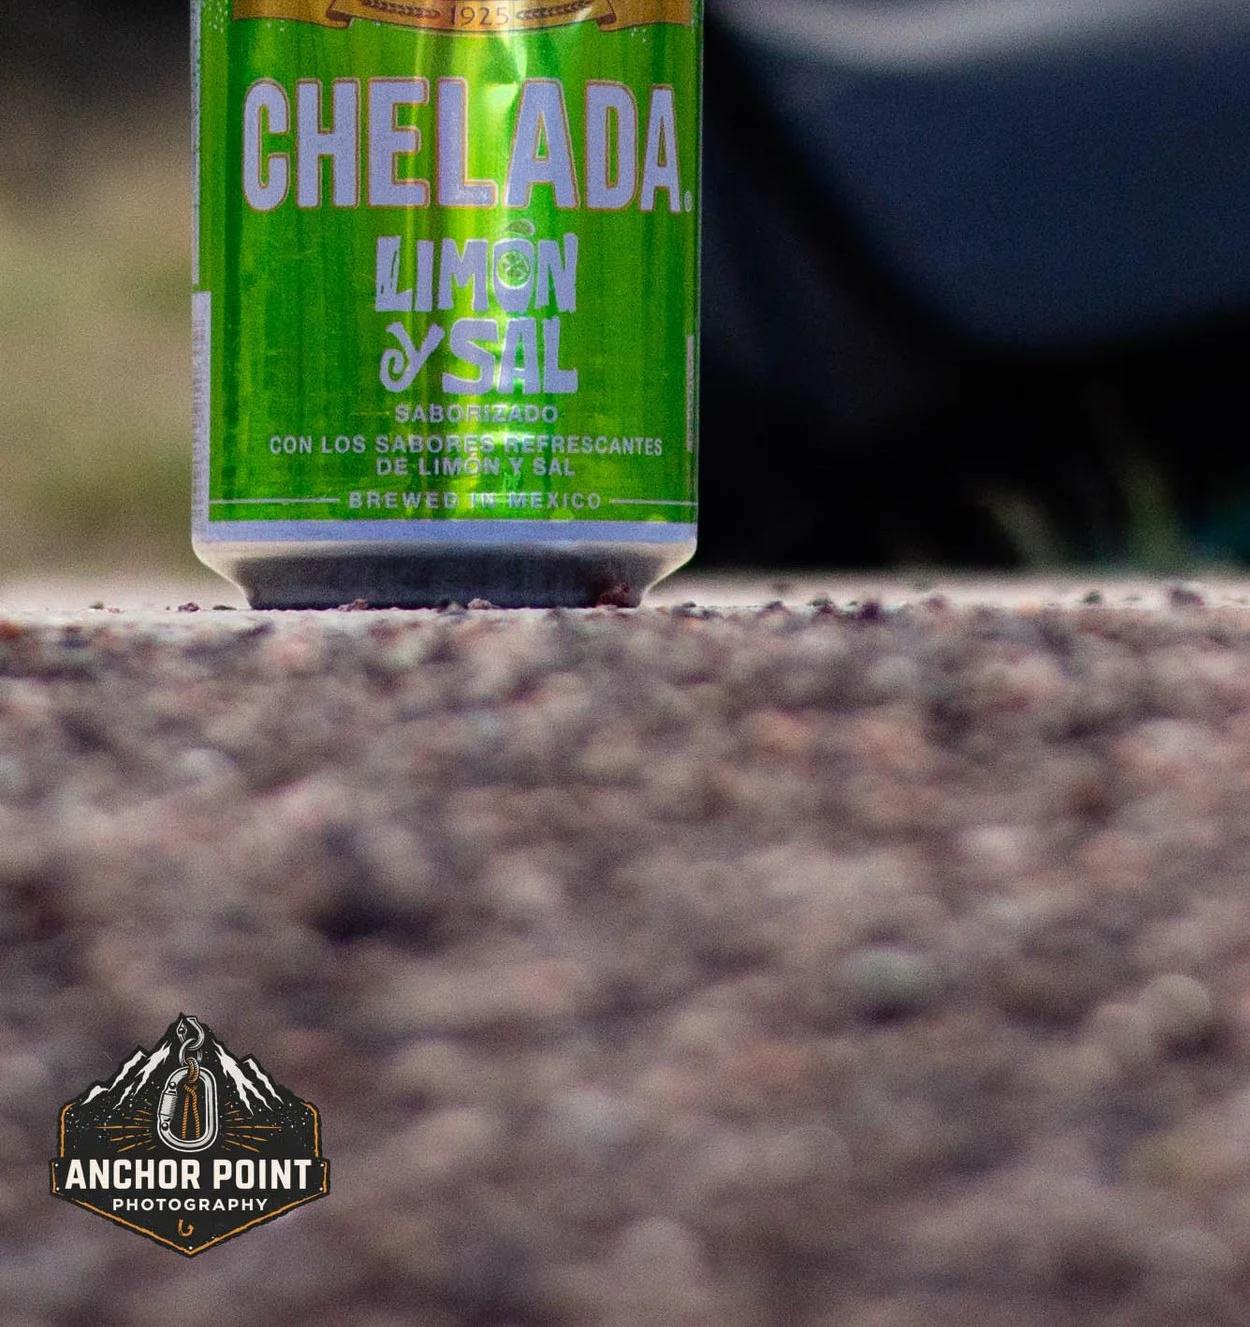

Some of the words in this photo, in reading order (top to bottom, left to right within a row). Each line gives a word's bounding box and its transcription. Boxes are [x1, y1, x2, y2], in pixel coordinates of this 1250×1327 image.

[450, 6, 509, 26] 1925
[441, 316, 579, 395] SAL
[394, 404, 558, 424] SABORIZADO
[269, 434, 313, 455] CON
[321, 434, 366, 454] LOS
[375, 434, 495, 454] SABORES
[504, 434, 663, 457] REFRESCANTES
[376, 457, 408, 476] DE
[418, 452, 500, 476] LIMÓN
[508, 457, 524, 476] Y
[532, 457, 575, 477] SAL
[348, 491, 458, 509] BREWED
[470, 492, 497, 509] IN
[508, 492, 601, 510] MEXICO
